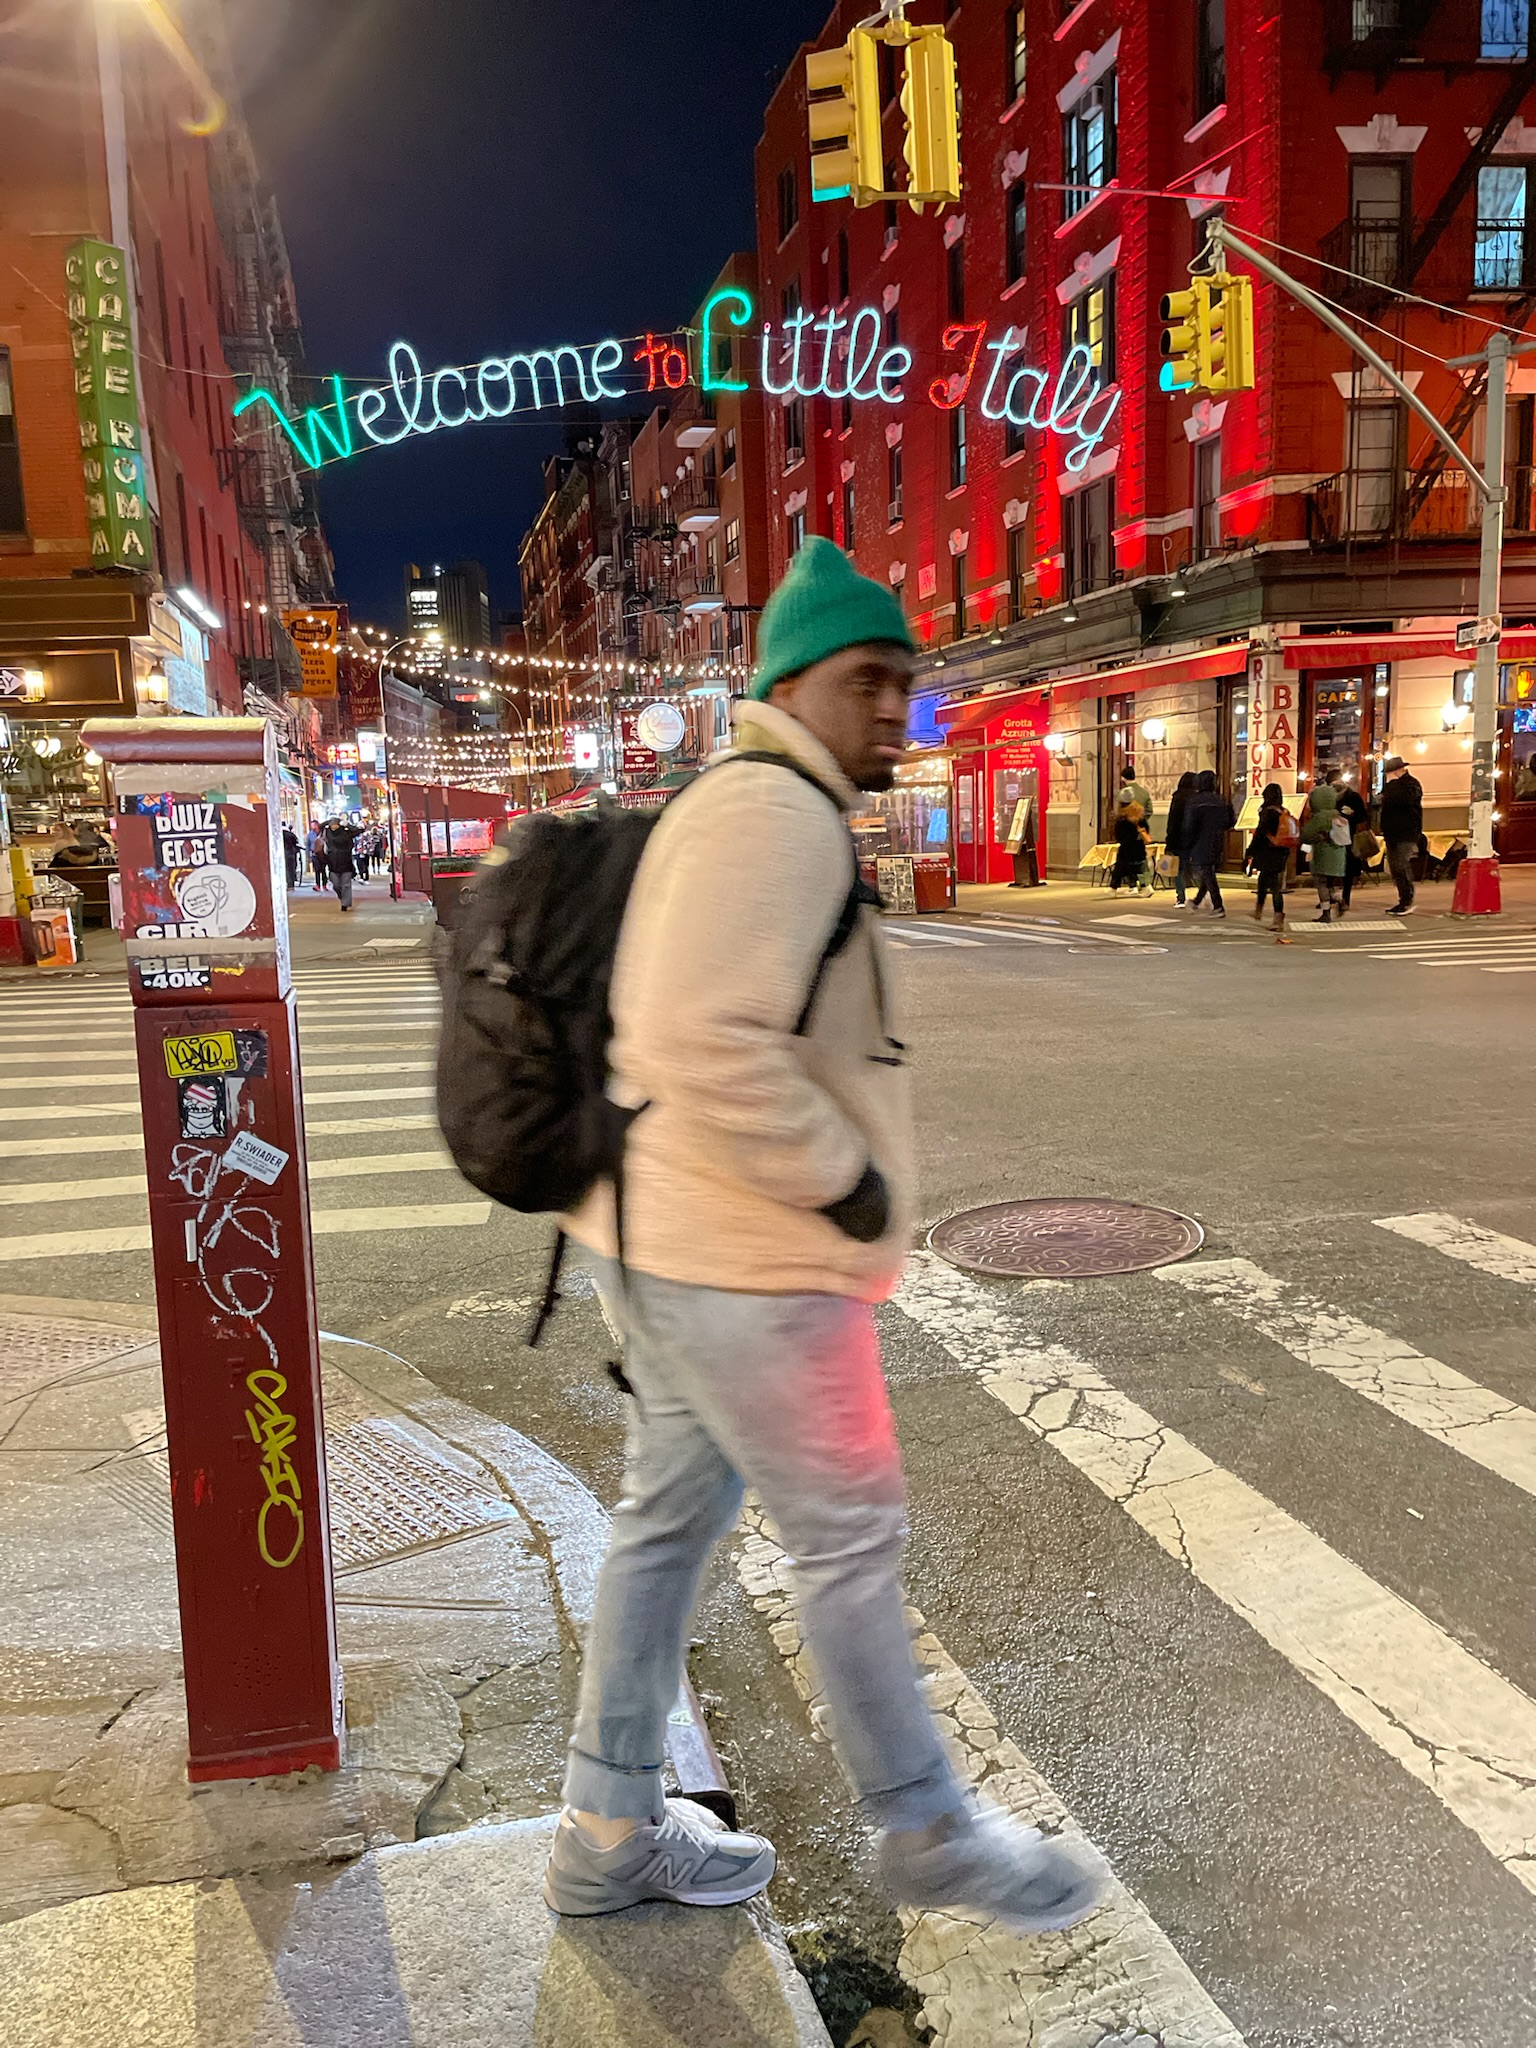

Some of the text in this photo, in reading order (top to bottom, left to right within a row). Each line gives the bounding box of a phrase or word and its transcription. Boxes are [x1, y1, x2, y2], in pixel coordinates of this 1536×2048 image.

[232, 288, 1121, 472] Welcome to Little Italy
[94, 255, 145, 557] CAFE ROMA
[300, 648, 322, 656] Beer
[1000, 728, 1036, 738] Azzurra
[1003, 718, 1033, 728] Grotta
[1268, 684, 1295, 770] BAR
[234, 1137, 284, 1169] R.SWIADER
